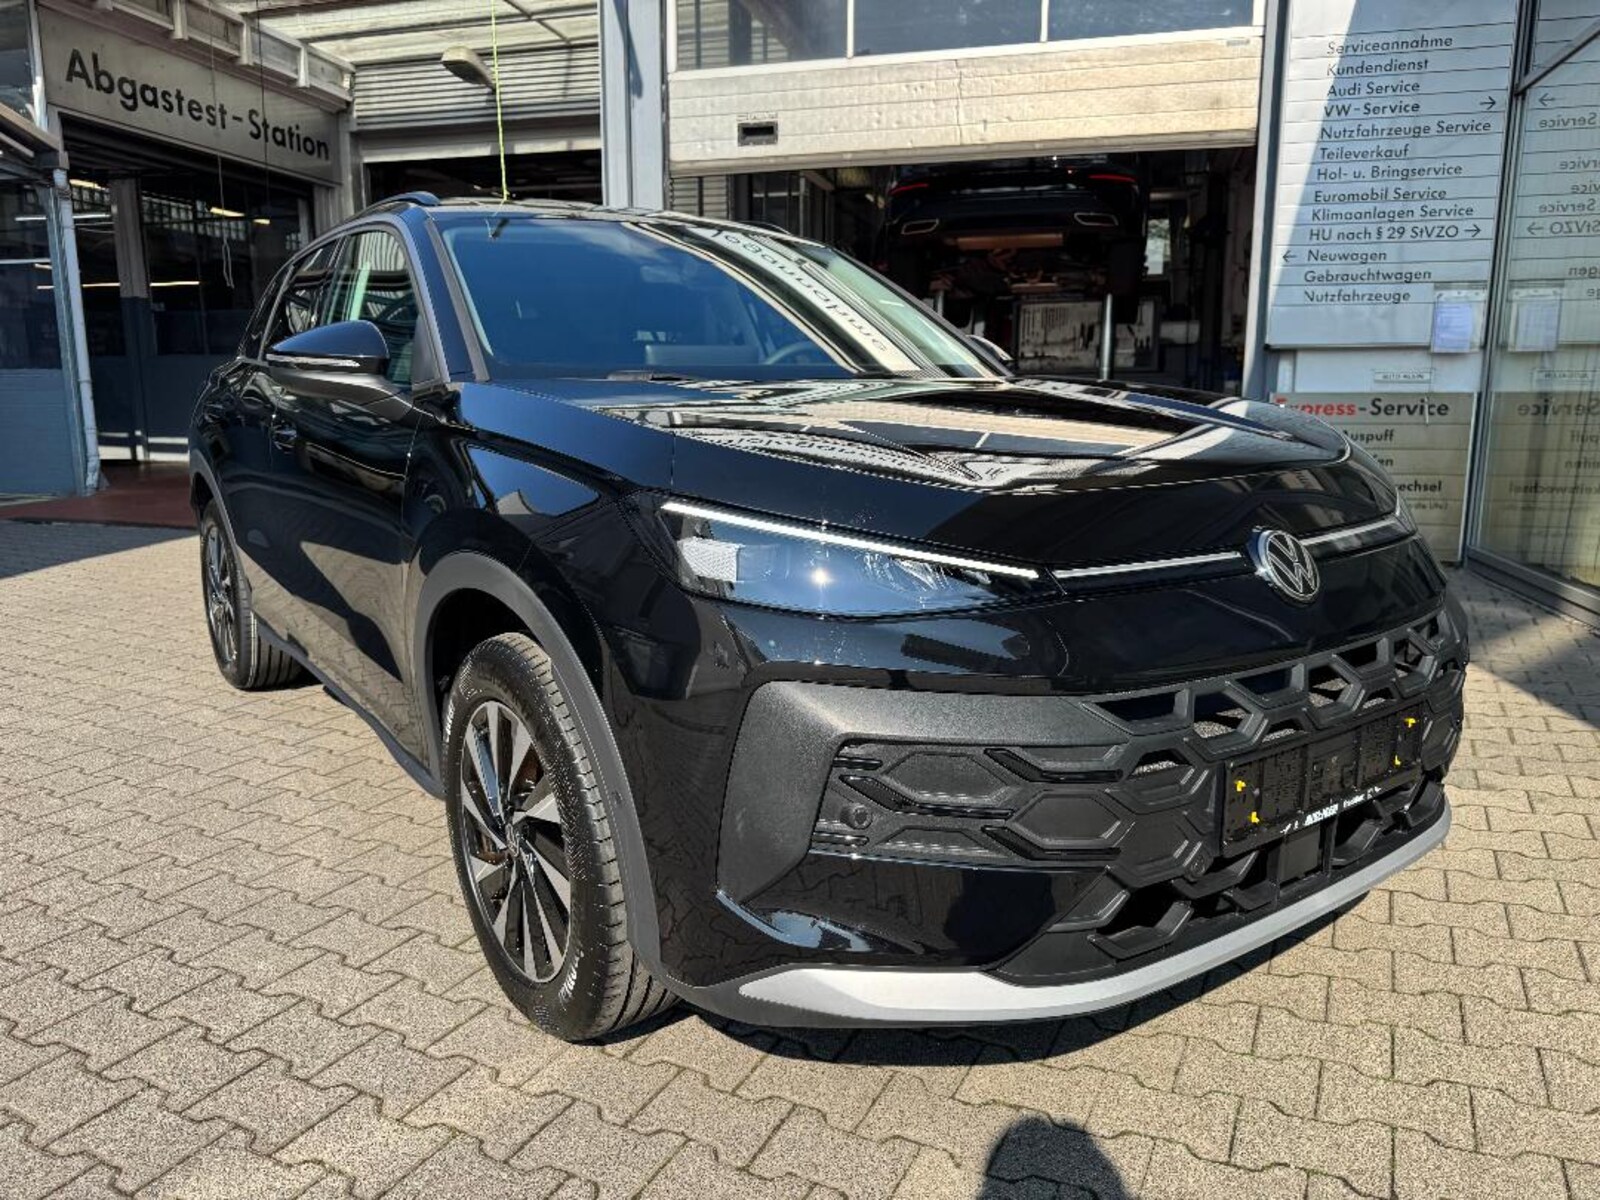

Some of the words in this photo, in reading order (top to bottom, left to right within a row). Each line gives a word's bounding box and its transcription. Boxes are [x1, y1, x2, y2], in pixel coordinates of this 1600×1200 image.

[1326, 35, 1453, 56] Serviceannahme
[1326, 58, 1429, 77] Kundendienst
[1326, 82, 1361, 98] Audi
[1366, 80, 1420, 95] Service
[65, 47, 330, 161] Abgastest-Station
[1320, 123, 1431, 140] Nutzfahrzeuge
[1436, 119, 1491, 134] Service
[1320, 145, 1409, 160] Teileverkauf
[1317, 166, 1348, 181] Hol-
[1353, 168, 1366, 180] u.
[1371, 163, 1463, 181] Bringservice
[1314, 188, 1388, 203] Euromobil
[1393, 187, 1447, 201] Service
[1311, 206, 1415, 222] Klimaanlagen
[1420, 204, 1474, 218] Service
[1309, 228, 1332, 241] HU
[1336, 226, 1372, 241] nach
[1376, 226, 1383, 241] §
[1387, 226, 1405, 240] 29
[1410, 225, 1459, 239] StVZO
[1307, 249, 1387, 264] Neuwagen
[1304, 268, 1432, 285] Gebrauchtwagen
[1304, 289, 1411, 305] Nutzfahrzeuge
[1275, 397, 1449, 417] press-Service
